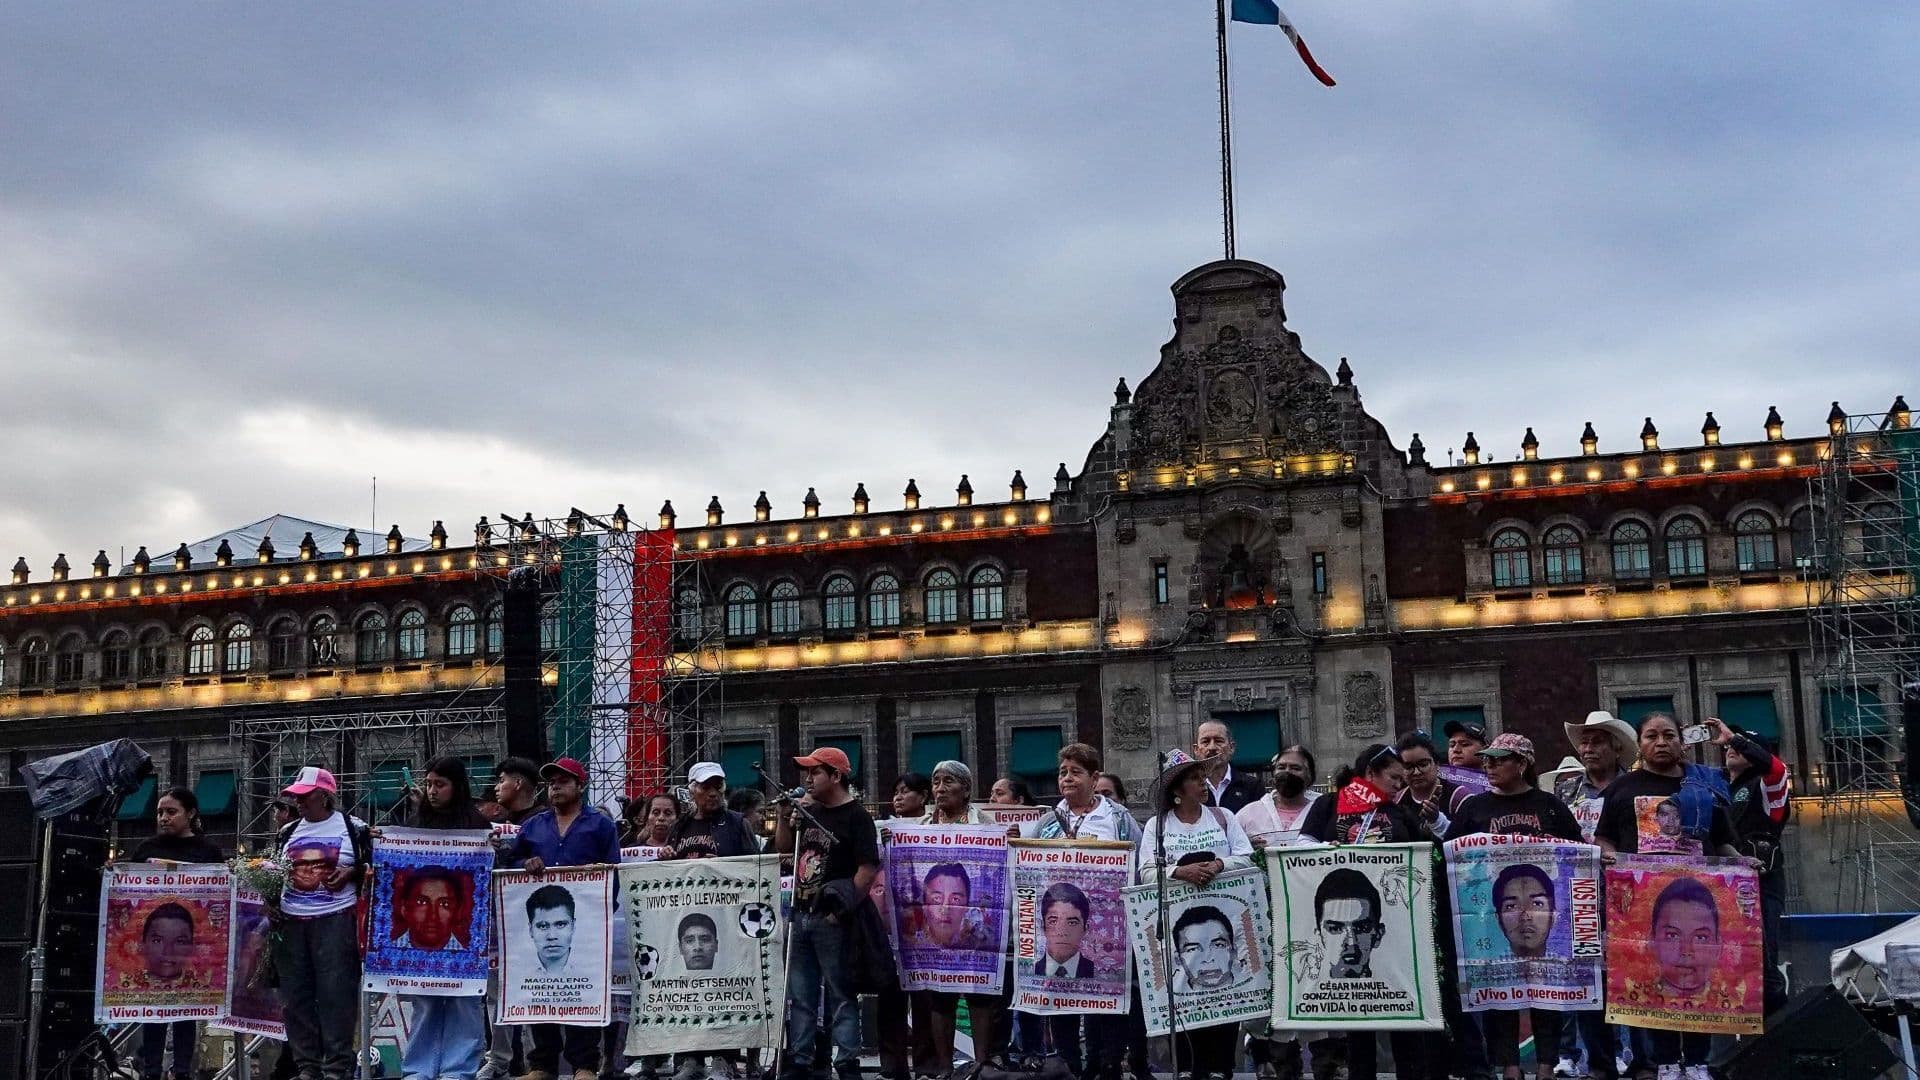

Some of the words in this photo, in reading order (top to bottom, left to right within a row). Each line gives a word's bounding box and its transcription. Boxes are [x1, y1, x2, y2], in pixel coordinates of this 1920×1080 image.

[892, 832, 920, 847] ¡Vivo
[923, 835, 937, 844] se
[940, 834, 951, 845] lo
[954, 835, 1006, 847] llevaron!
[1454, 835, 1487, 851] ¡Vivo
[1491, 835, 1508, 845] se
[1017, 850, 1042, 864] ¡Vivo
[1046, 853, 1058, 862] se
[1061, 851, 1072, 863] lo
[1075, 852, 1127, 865] llevaron!
[1286, 857, 1316, 869] ¡Vivo
[1318, 857, 1332, 866] se
[1334, 853, 1346, 865] lo
[1348, 852, 1403, 864] llevaron!
[111, 874, 141, 886] ¡Vivo
[145, 876, 160, 885] se
[163, 874, 174, 885] lo
[178, 874, 228, 885] llevaron!
[1572, 879, 1596, 898] NOS
[1019, 900, 1035, 935] FALTAN
[1573, 903, 1599, 942] FALTAN
[1020, 937, 1035, 958] NOS
[386, 978, 408, 987] ¡Vivo
[652, 977, 688, 989] MARTÍN
[692, 977, 756, 988] GETSEMANY
[940, 973, 990, 984] ueremos!
[1320, 981, 1349, 990] CÉSAR
[1351, 981, 1388, 990] MANUEL
[648, 991, 699, 1003] SÁNCHEZ
[704, 988, 754, 1001] GARCÍA
[1020, 992, 1038, 1005] ¡Vivo
[1040, 994, 1050, 1006] lo
[1053, 997, 1117, 1010] queremos!
[1303, 991, 1350, 1000] GONZÁLEZ
[1351, 991, 1407, 1000] HERNÁNDEZ
[1476, 988, 1507, 1003] ¡Vivo
[1511, 987, 1523, 999] lo
[1526, 987, 1588, 1000] queremos!
[109, 1007, 138, 1019] ¡Vivo
[142, 1007, 153, 1017] lo
[156, 1006, 219, 1018] queremos!
[527, 1004, 546, 1015] VIDA
[549, 1005, 557, 1015] lo
[559, 1005, 601, 1017] queremos!
[707, 1003, 760, 1012] queremos!
[1296, 1002, 1319, 1015] ¡Con
[1320, 1002, 1346, 1013] VIDA
[1348, 1000, 1358, 1012] lo
[1359, 1001, 1414, 1015] queremos!
[1184, 1012, 1209, 1024] VIDA
[1210, 1009, 1220, 1020] lo
